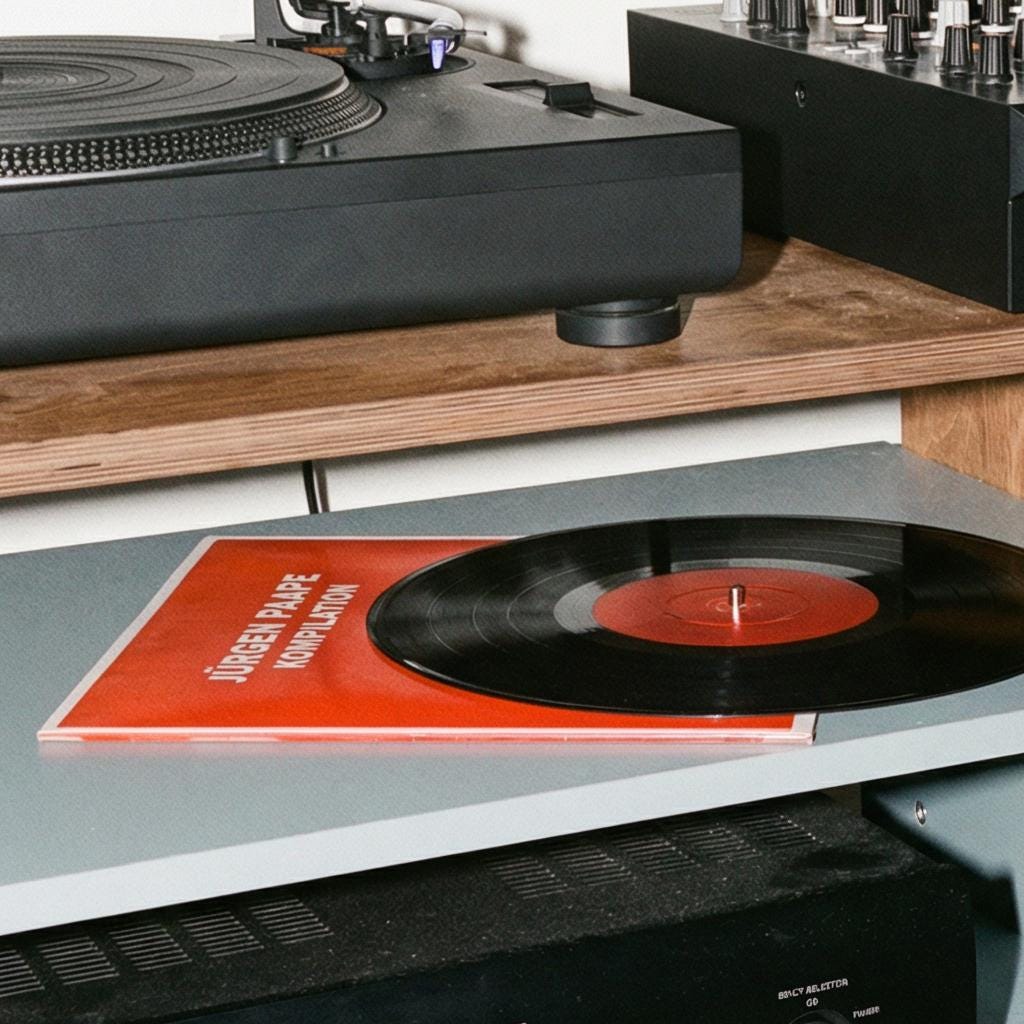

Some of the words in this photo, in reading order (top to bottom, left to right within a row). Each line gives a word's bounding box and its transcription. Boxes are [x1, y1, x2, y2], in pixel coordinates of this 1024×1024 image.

[203, 623, 287, 684] JÜRGEN
[254, 573, 322, 619] PAAPE
[272, 584, 361, 669] KOMPILATION
